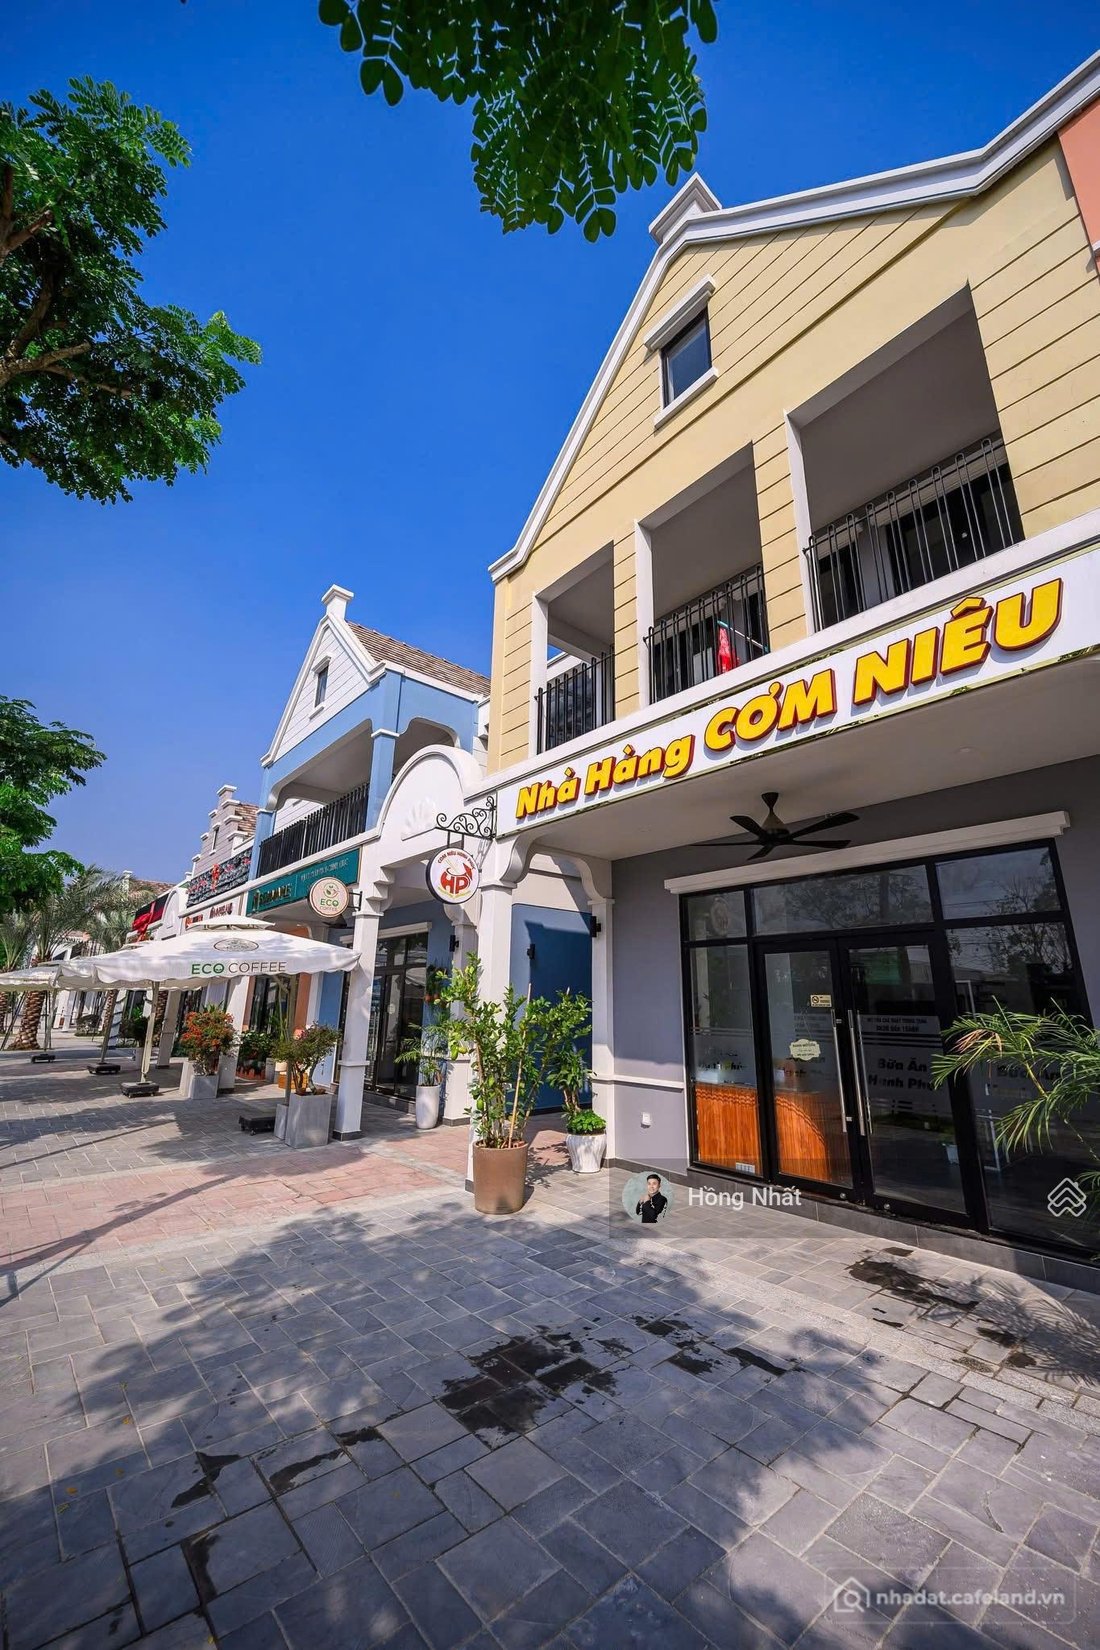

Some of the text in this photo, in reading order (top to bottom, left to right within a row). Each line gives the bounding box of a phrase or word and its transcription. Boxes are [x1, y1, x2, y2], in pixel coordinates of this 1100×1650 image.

[515, 577, 1065, 819] Nhà Hàng CƠM NIÊU
[320, 898, 339, 907] ECO
[191, 962, 287, 975] ECO COFFEE
